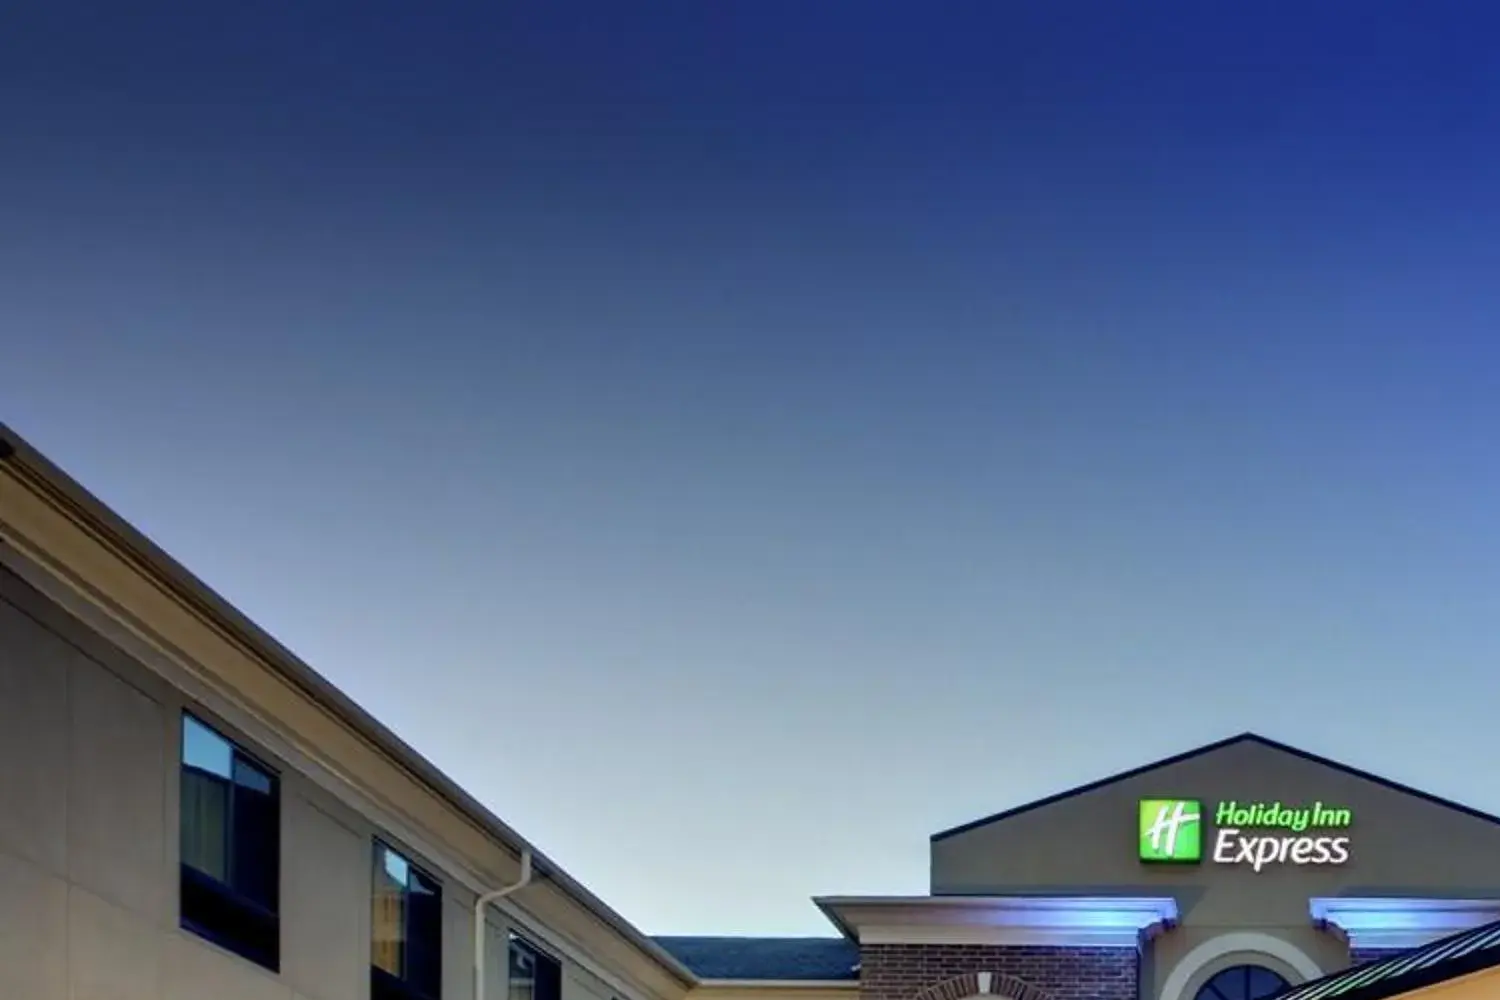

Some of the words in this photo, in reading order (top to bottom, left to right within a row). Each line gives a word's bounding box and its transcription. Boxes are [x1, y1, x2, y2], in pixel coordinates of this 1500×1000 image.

[1216, 801, 1309, 831] Holiday
[1312, 801, 1350, 826] Inn
[1213, 828, 1349, 872] Express
